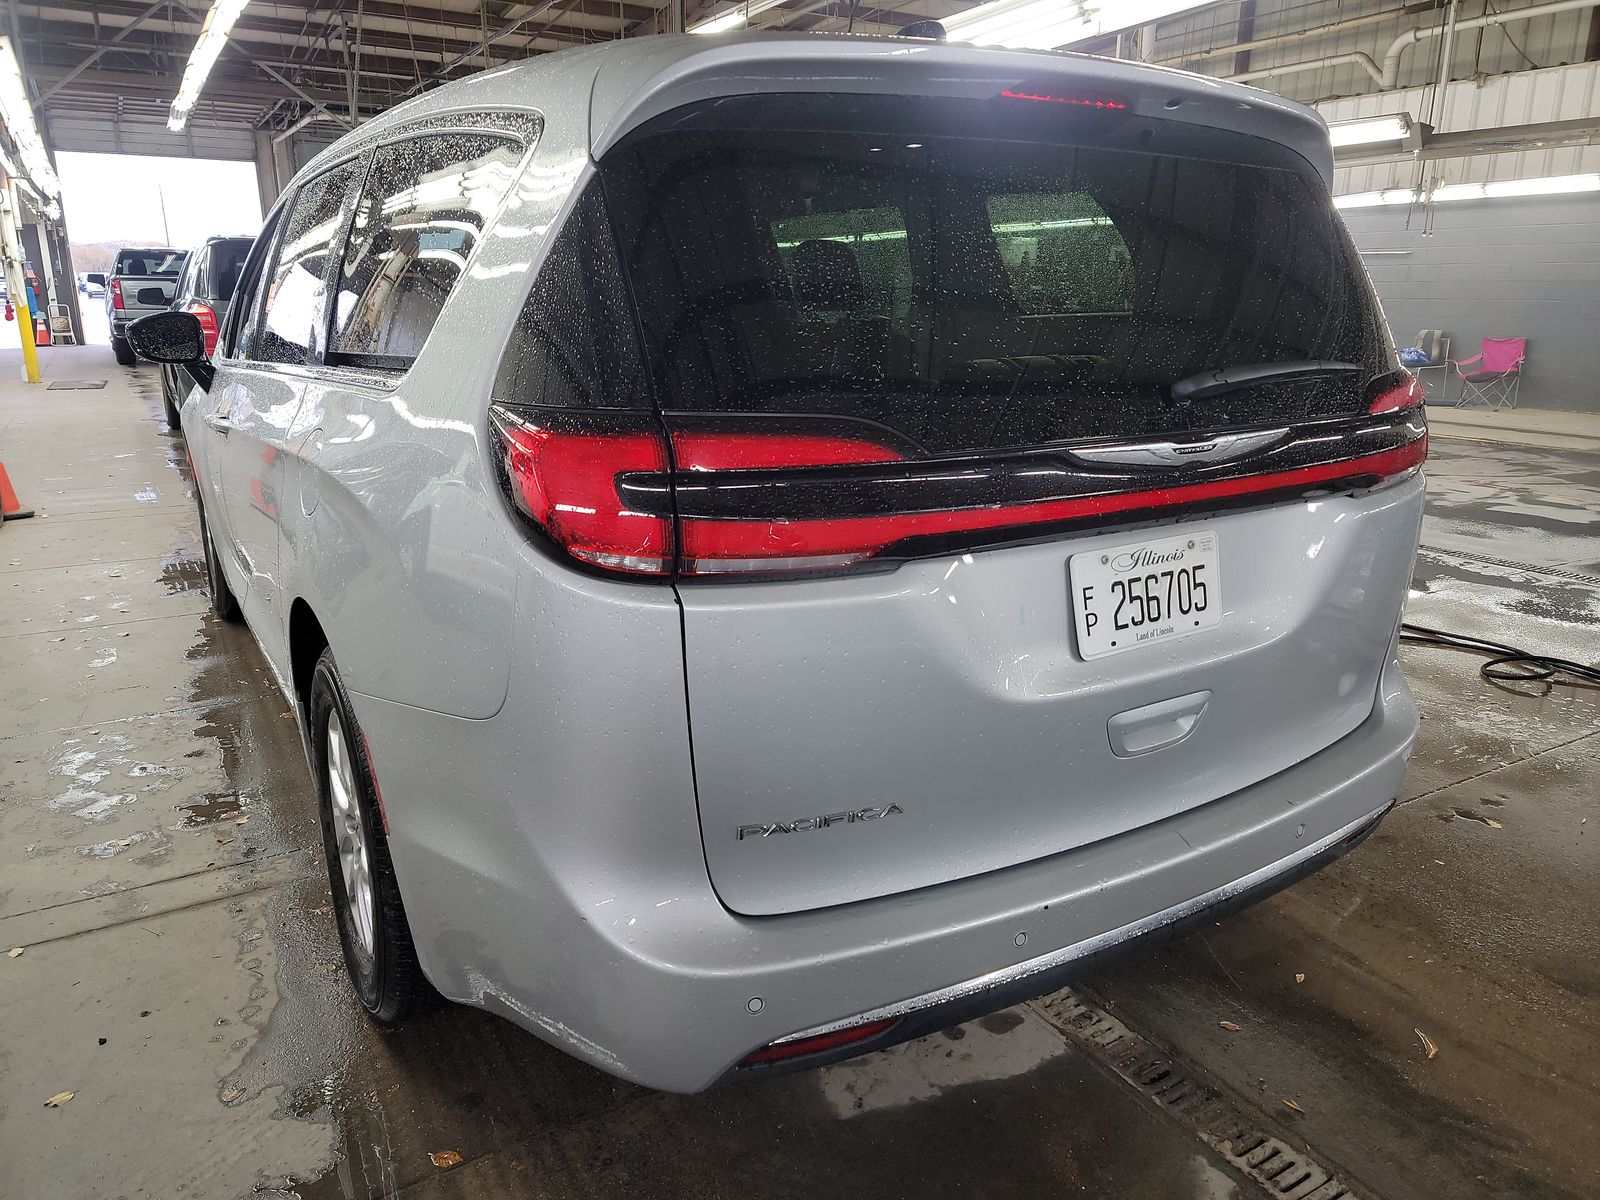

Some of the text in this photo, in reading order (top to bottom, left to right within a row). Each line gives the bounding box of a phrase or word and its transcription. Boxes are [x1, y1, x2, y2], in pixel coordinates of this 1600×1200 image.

[1110, 547, 1185, 573] Illinois
[1111, 564, 1207, 631] 256705
[1135, 625, 1174, 642] Land of Lincoln
[736, 802, 904, 841] PACIFICA
